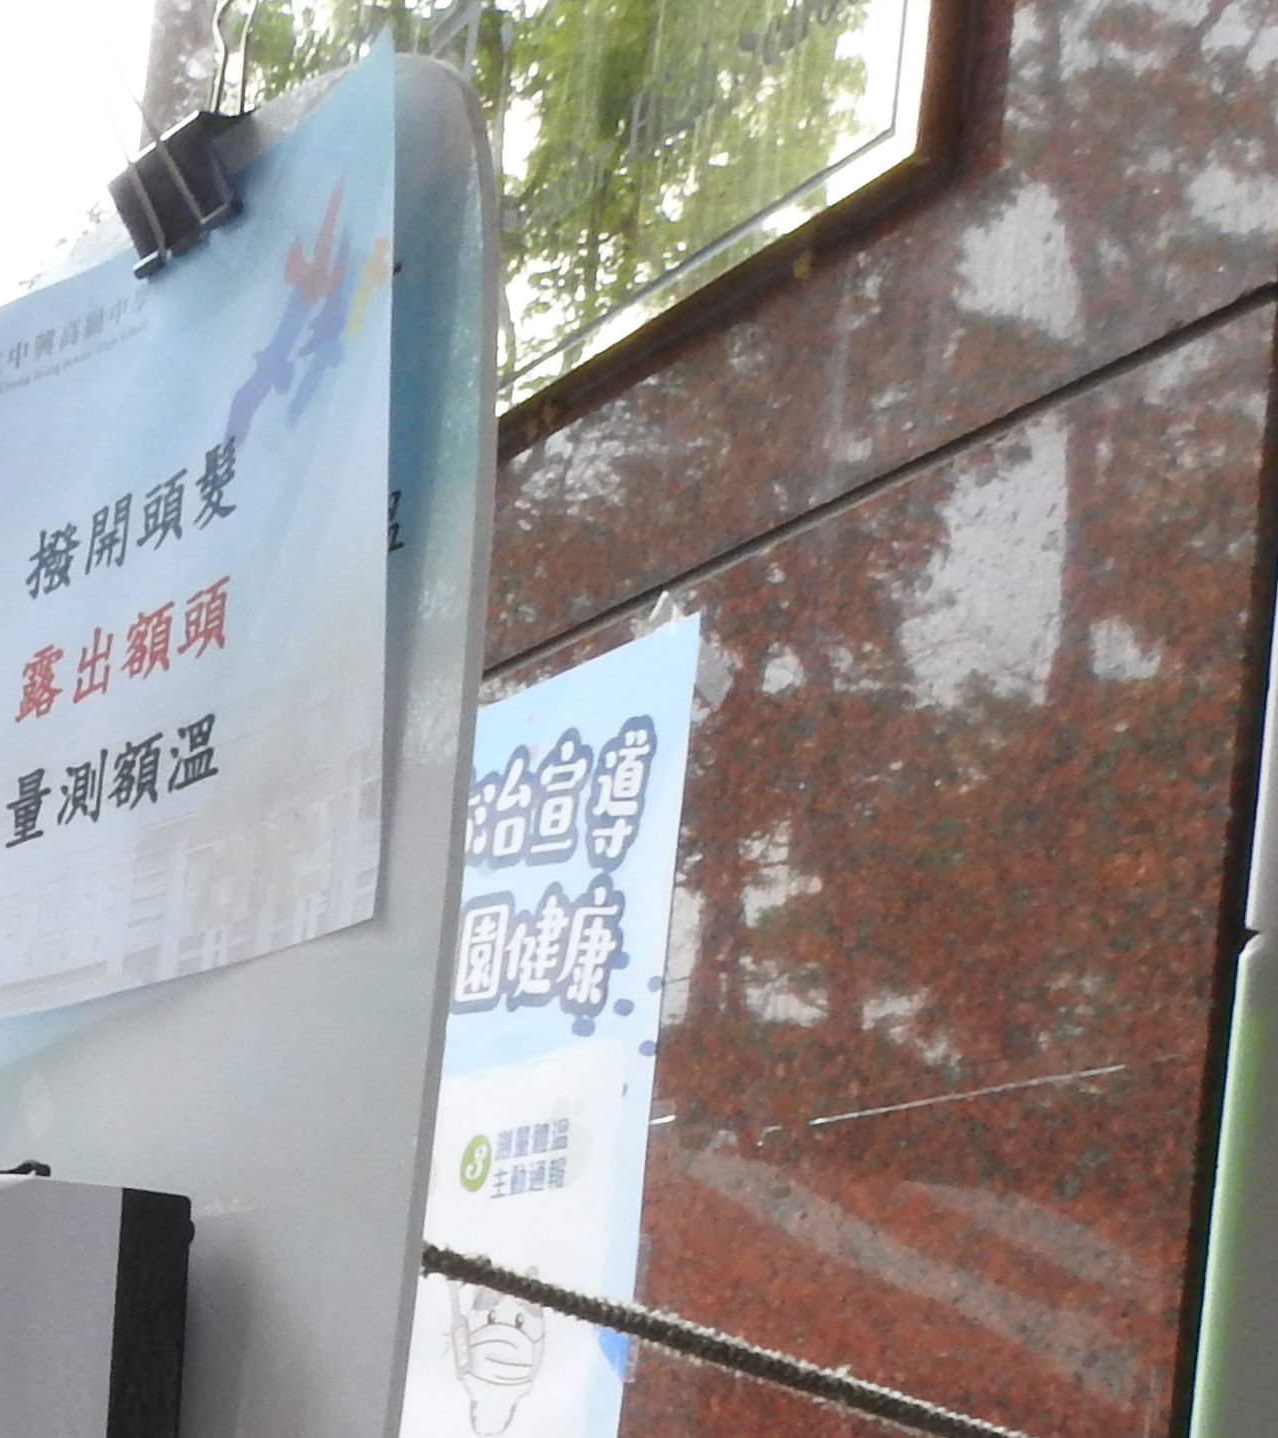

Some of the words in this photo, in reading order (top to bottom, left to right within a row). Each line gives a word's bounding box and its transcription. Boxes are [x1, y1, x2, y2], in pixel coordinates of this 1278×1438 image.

[25, 435, 237, 599] 撥開頭髮
[14, 574, 230, 723] 露出額頭
[5, 713, 219, 848] 量測額溫
[464, 720, 653, 866] 治宣導
[451, 879, 621, 1010] 園健康
